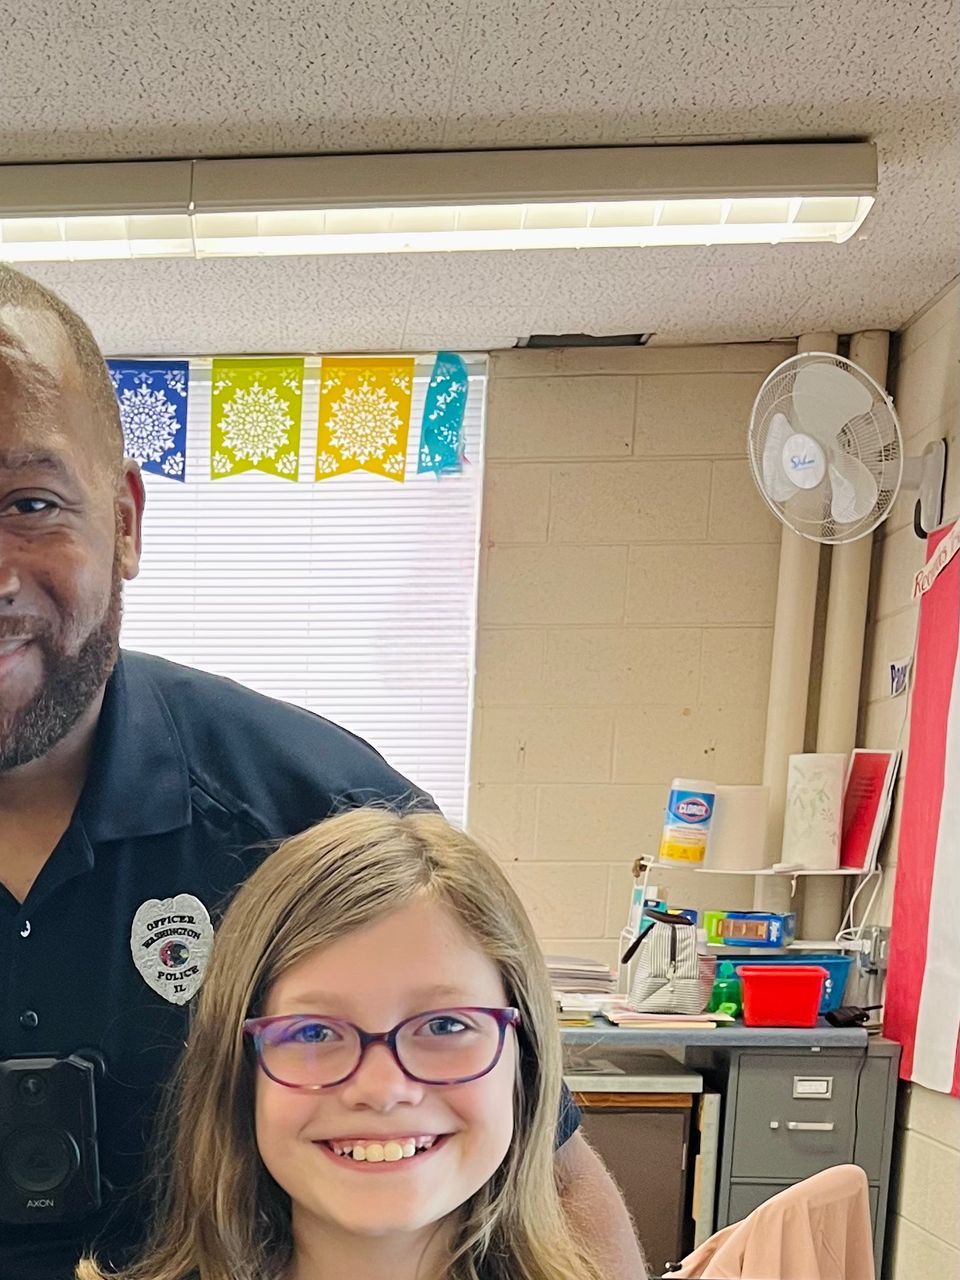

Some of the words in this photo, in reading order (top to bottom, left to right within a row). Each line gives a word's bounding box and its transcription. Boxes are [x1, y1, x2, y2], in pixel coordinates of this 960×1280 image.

[146, 915, 196, 932] OFFICER
[157, 965, 200, 981] POLICE
[173, 984, 187, 994] IL
[26, 1199, 55, 1209] AXON
